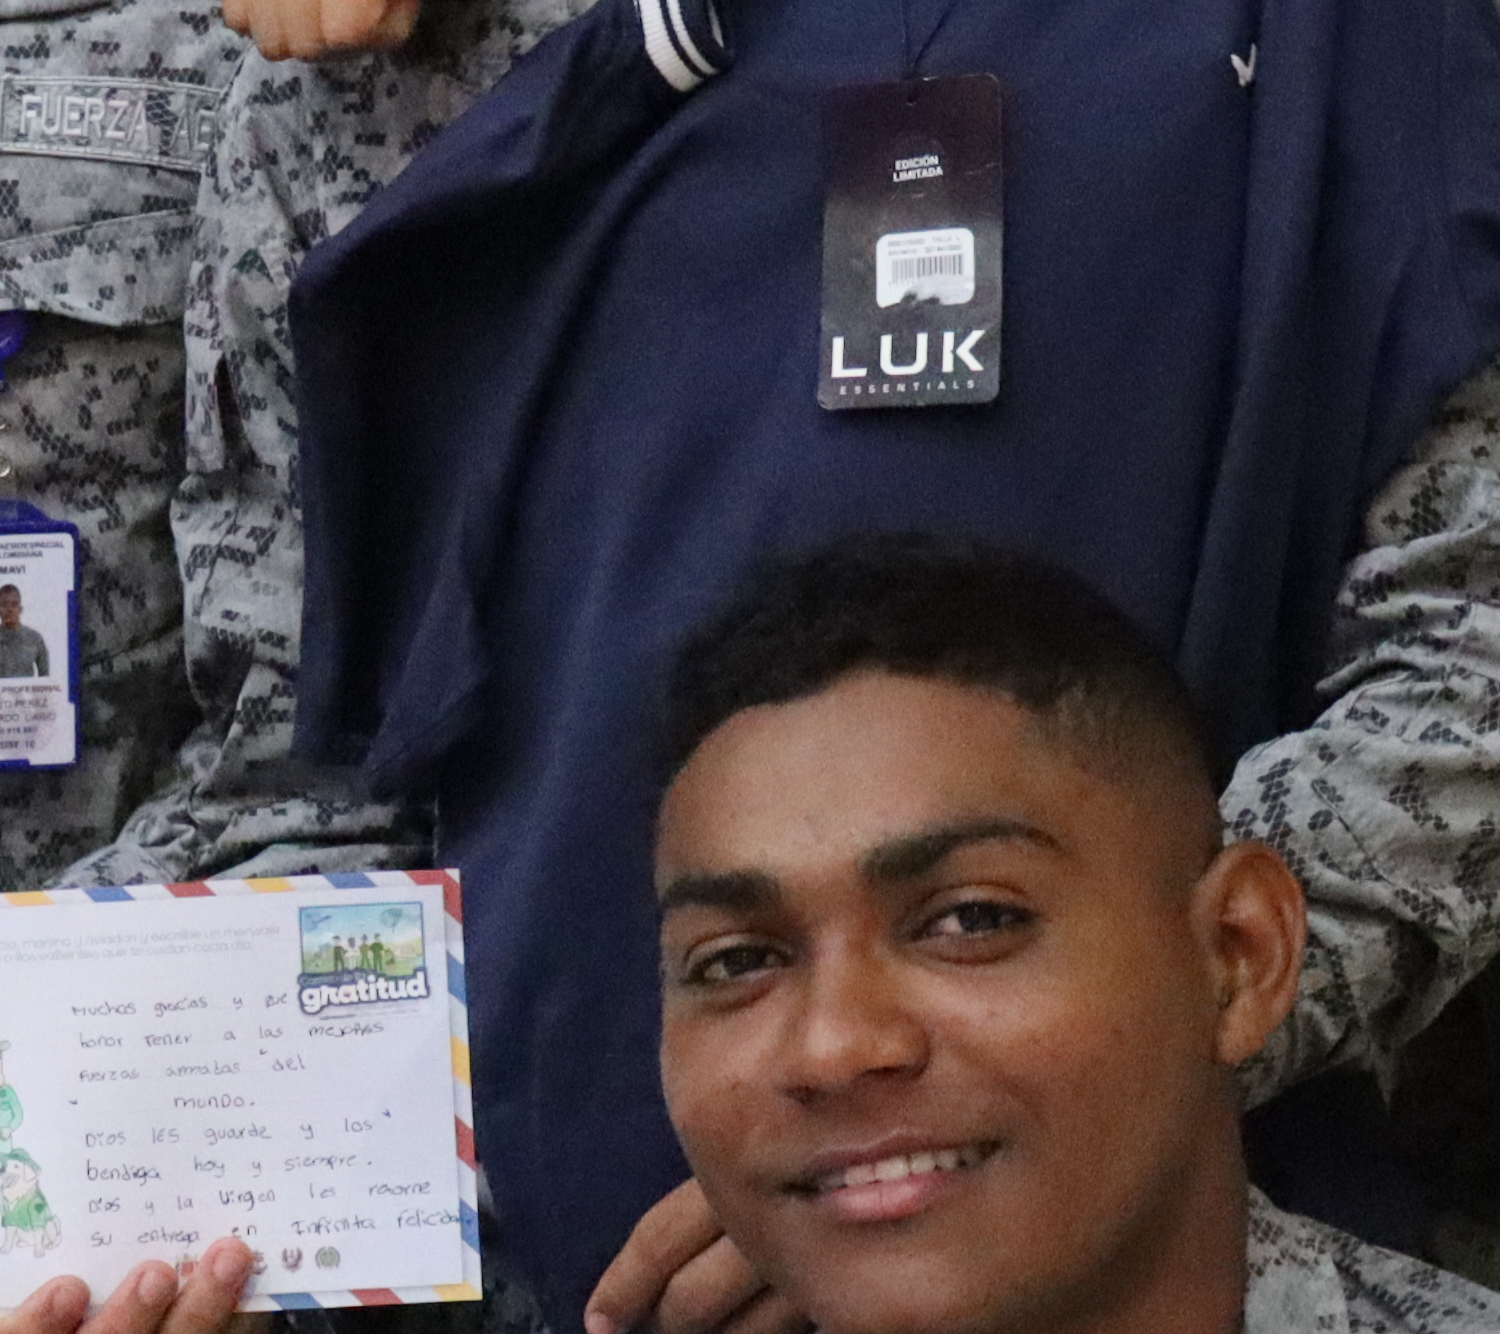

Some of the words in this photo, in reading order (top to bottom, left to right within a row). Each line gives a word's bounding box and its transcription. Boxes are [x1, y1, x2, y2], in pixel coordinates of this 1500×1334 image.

[19, 92, 149, 147] FUERZA
[892, 166, 944, 182] LIMITADA
[894, 154, 940, 171] EDICIÓN
[830, 329, 986, 379] LUK
[839, 379, 975, 396] ESSENTIALS
[300, 970, 429, 1014] gratitud
